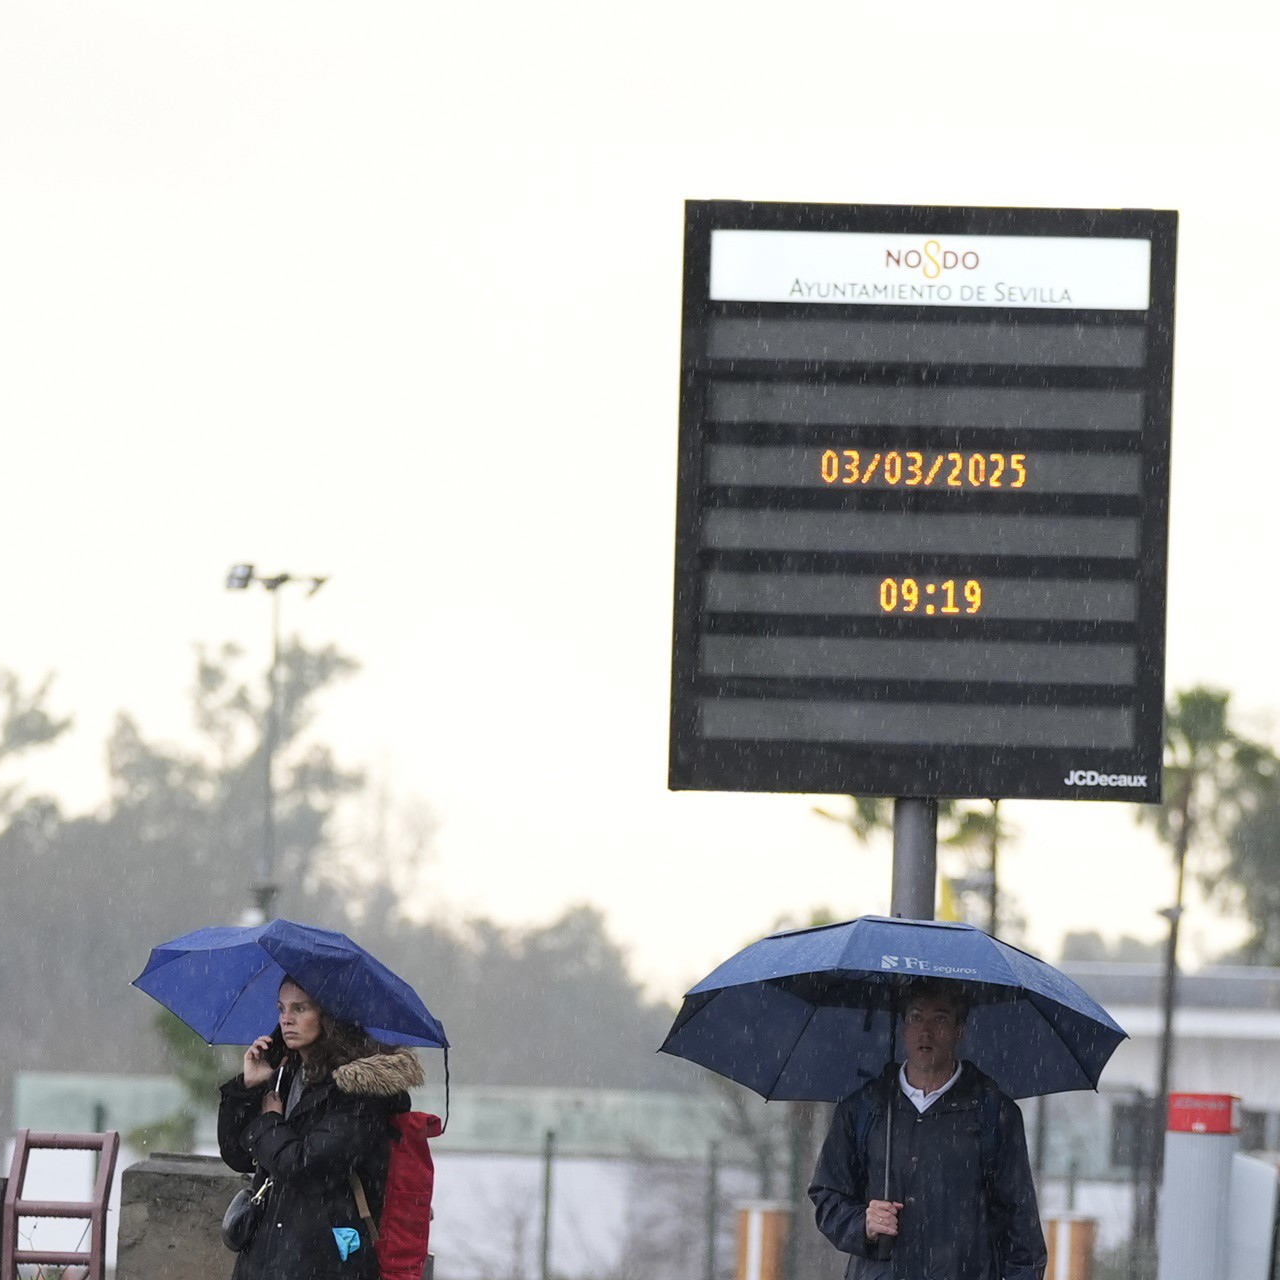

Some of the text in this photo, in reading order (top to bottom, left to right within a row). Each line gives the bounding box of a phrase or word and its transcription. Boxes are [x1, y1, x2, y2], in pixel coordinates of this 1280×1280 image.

[994, 281, 1072, 303] SEVILLA
[821, 449, 1027, 488] 03/03/2025
[879, 577, 982, 615] 09:19
[1063, 769, 1148, 788] JCDecaux
[932, 965, 978, 974] seguros
